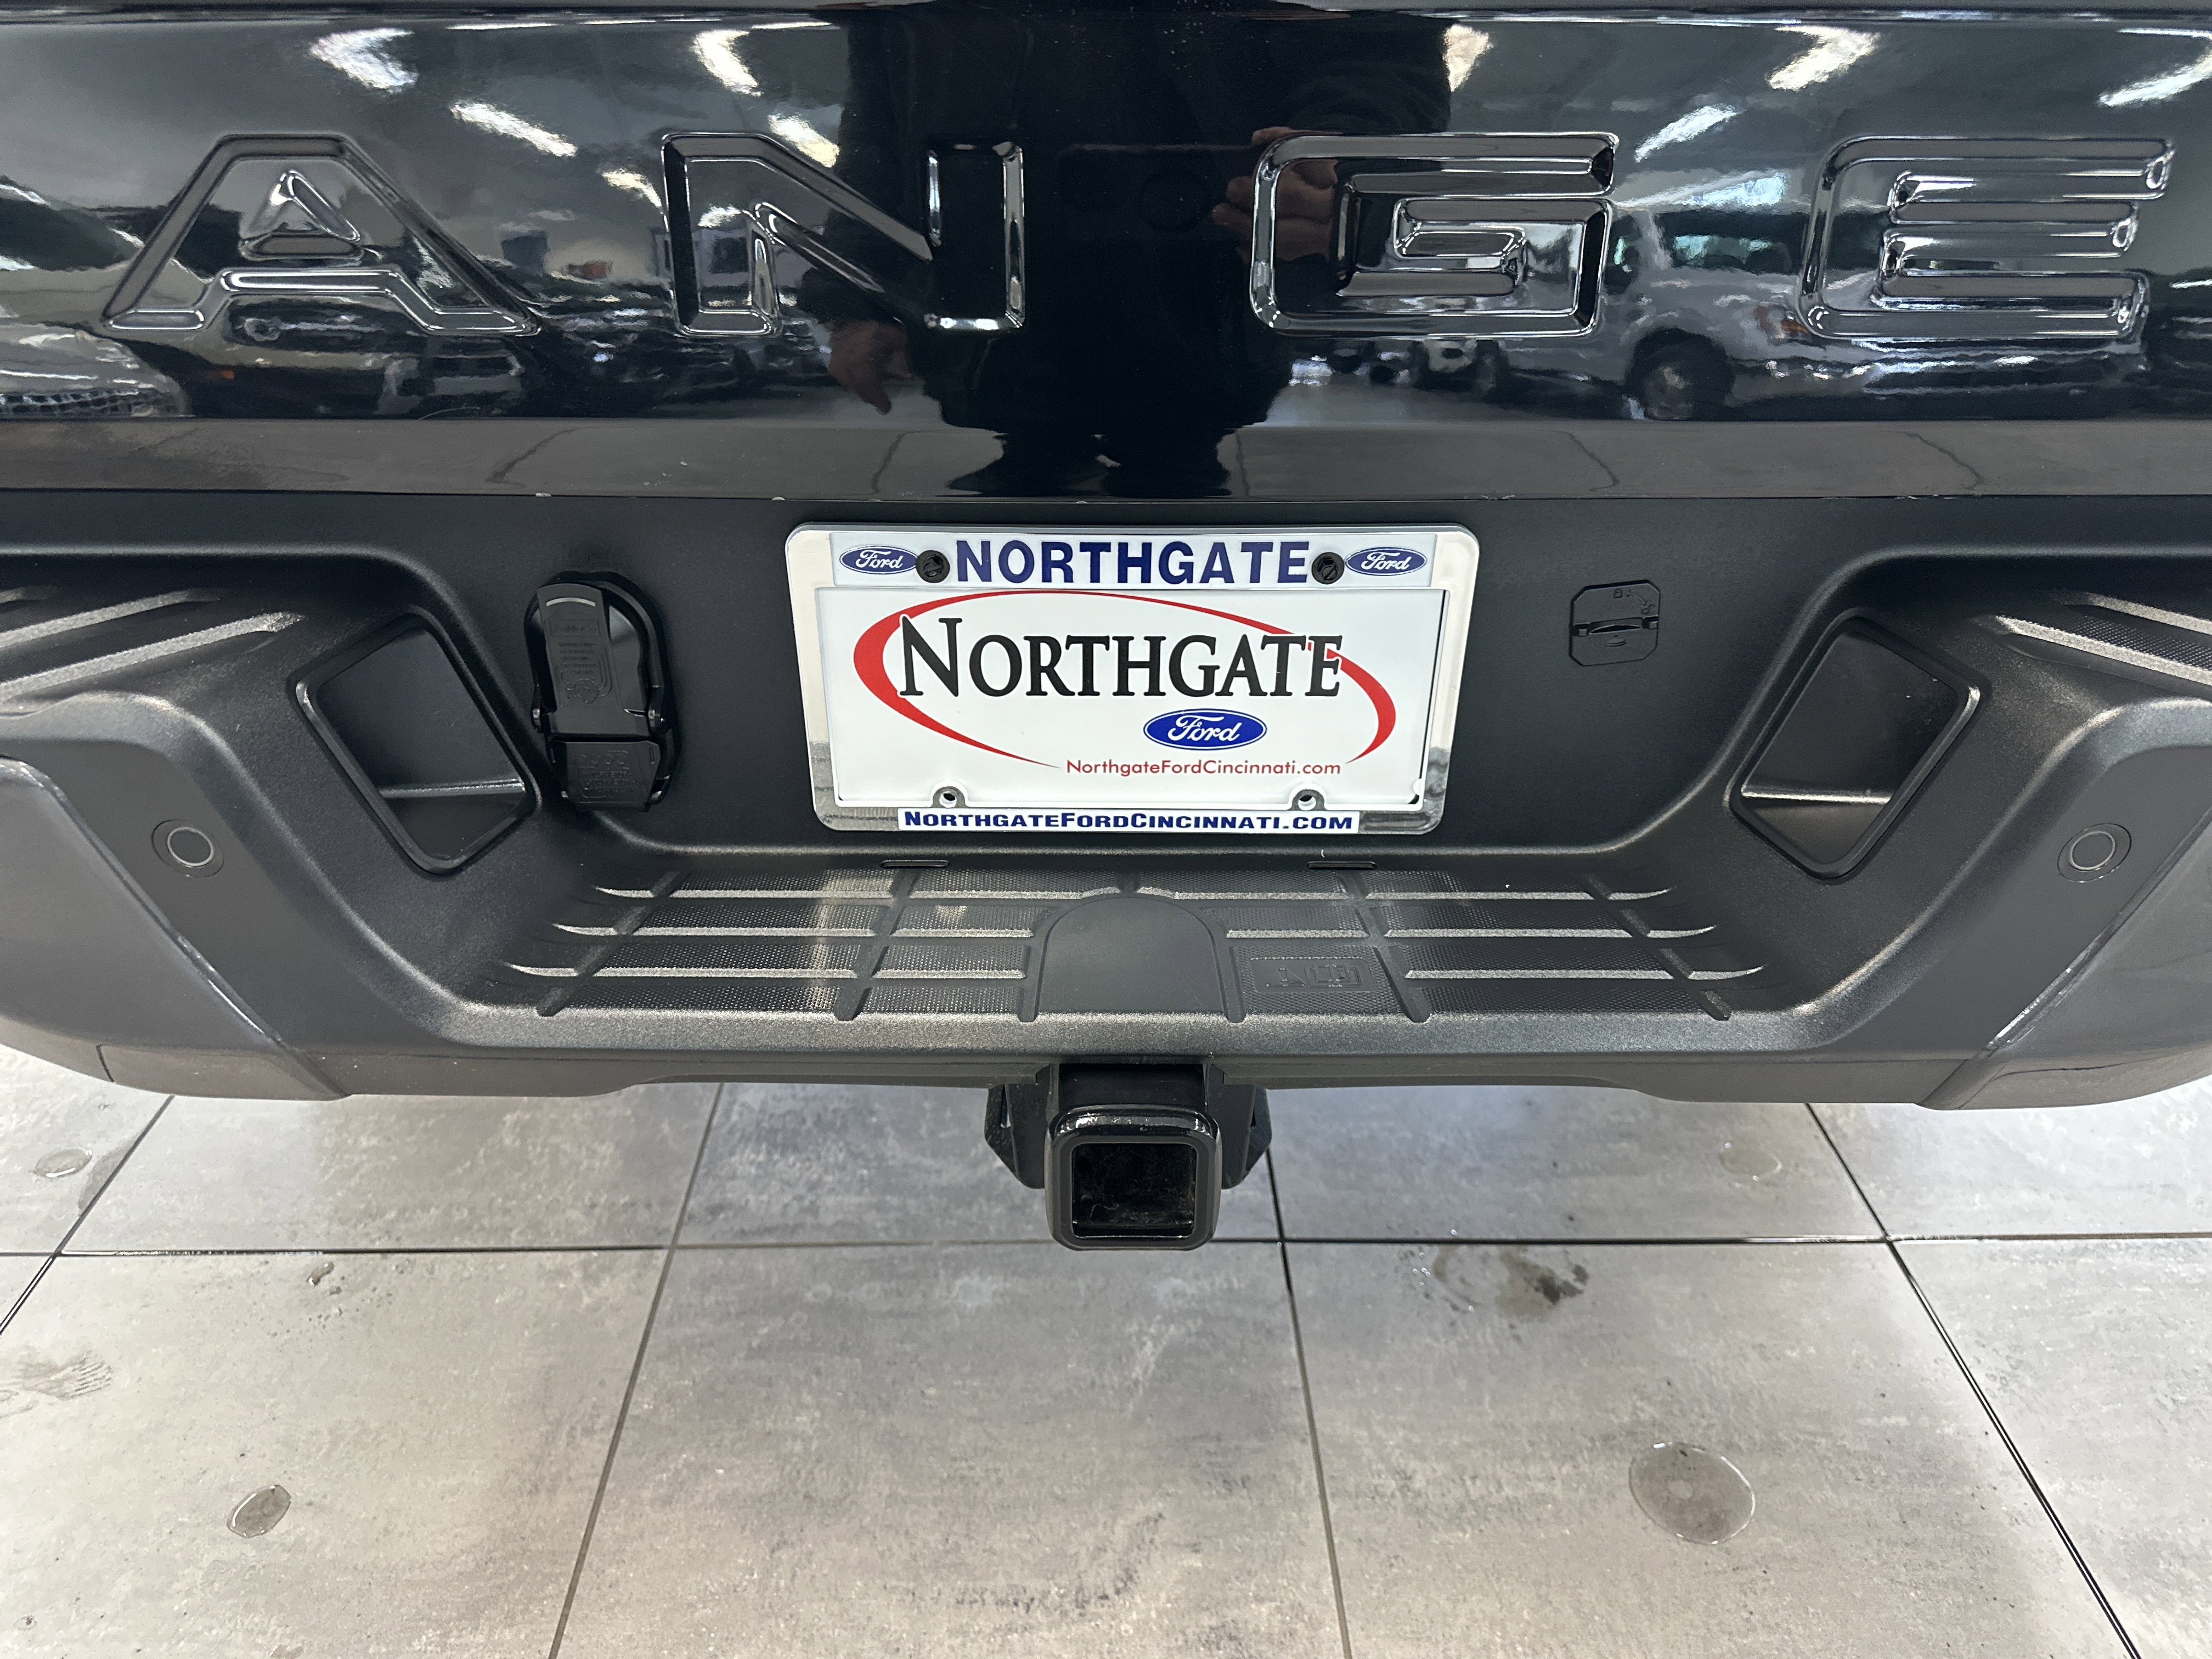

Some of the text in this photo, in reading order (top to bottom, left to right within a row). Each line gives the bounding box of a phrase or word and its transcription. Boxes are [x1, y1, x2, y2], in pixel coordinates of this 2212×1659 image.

[855, 550, 904, 568] Ford
[956, 540, 1310, 584] NORTHGATE
[1361, 552, 1412, 571] Ford
[899, 617, 1343, 698] NORTHGATE
[1167, 715, 1243, 741] Ford
[1066, 760, 1341, 776] NorthgateFordCincinnati.com
[905, 811, 1353, 830] NORTHGATEFORDCINCINNATI.COM
